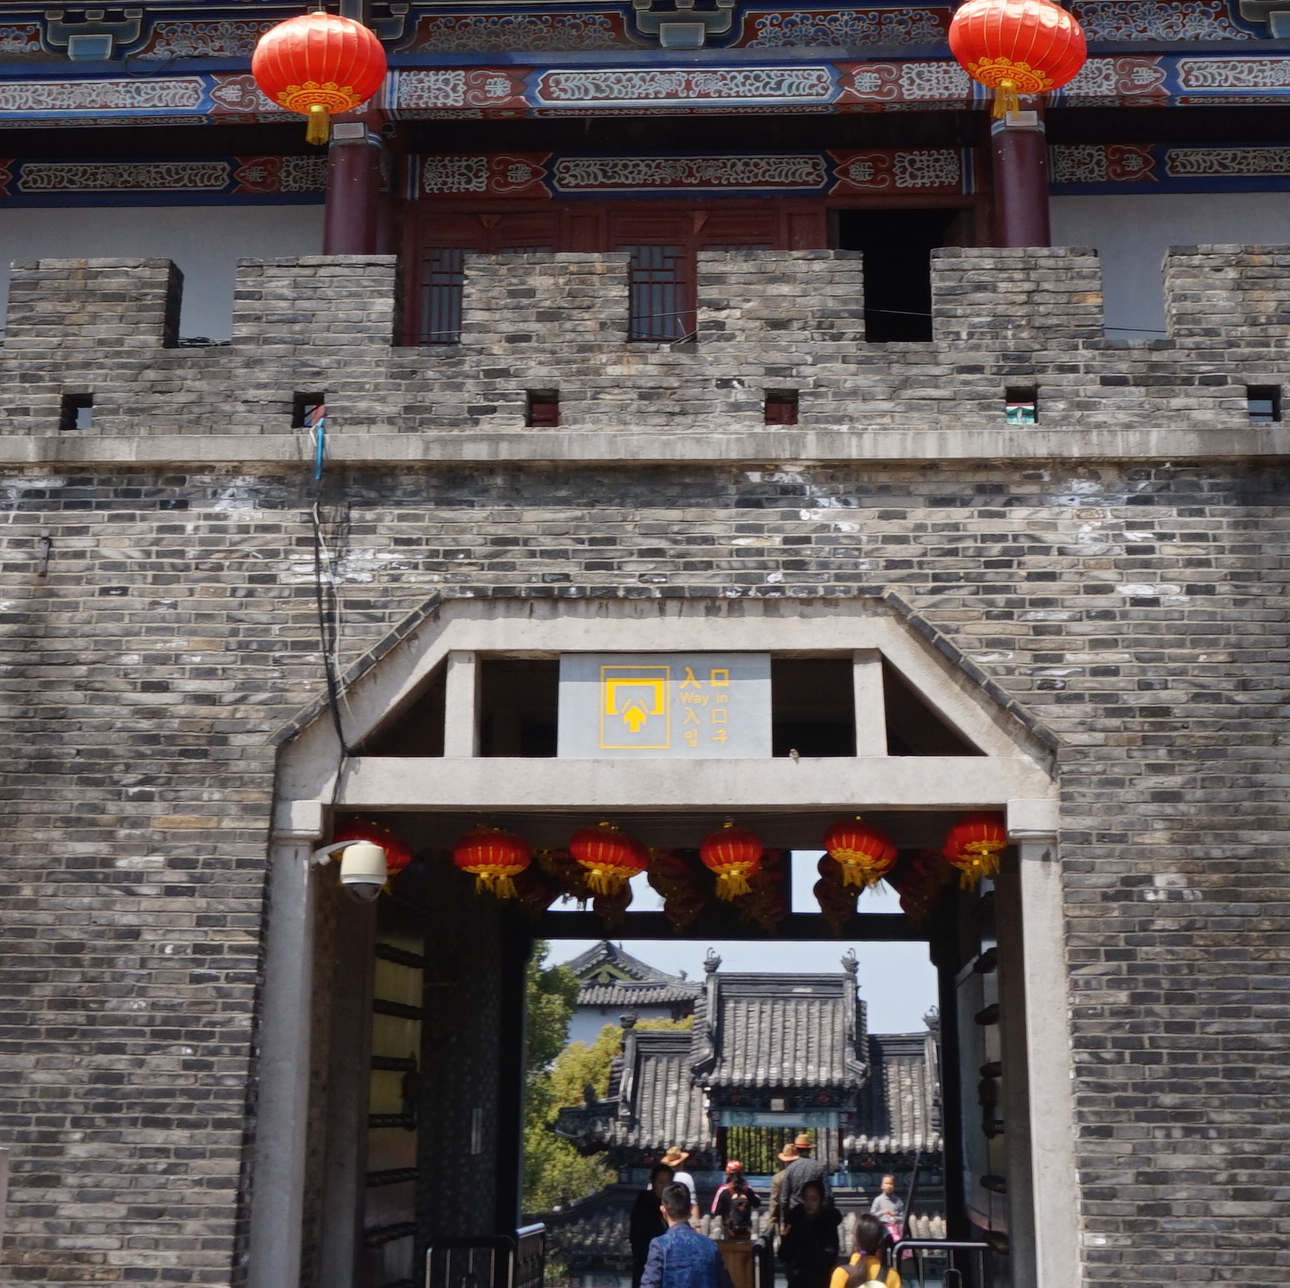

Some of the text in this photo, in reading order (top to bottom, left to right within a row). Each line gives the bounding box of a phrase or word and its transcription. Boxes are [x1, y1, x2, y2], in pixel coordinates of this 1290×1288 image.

[678, 666, 730, 689] 入口
[679, 692, 728, 707] Way in
[683, 707, 728, 724] 入口
[683, 728, 728, 747] 입구
